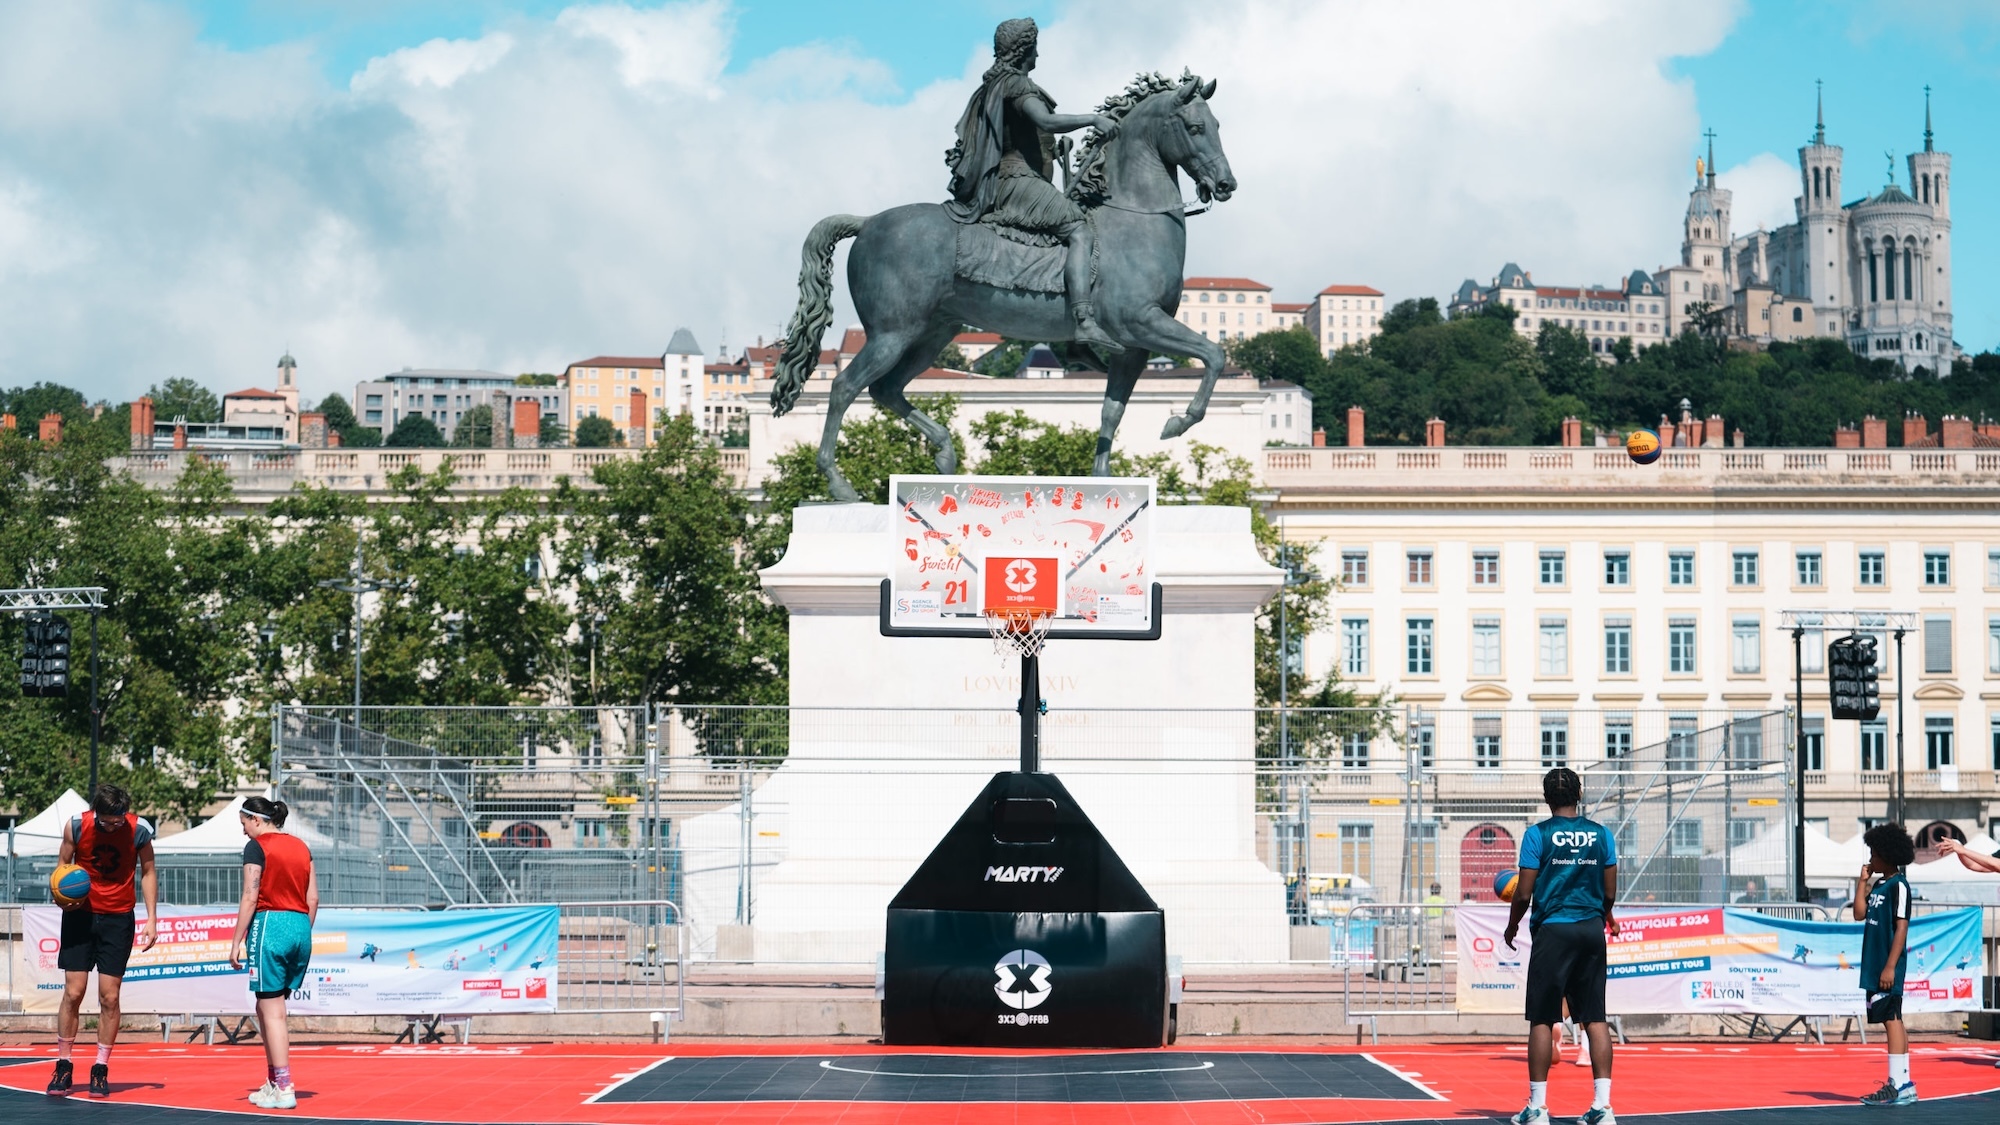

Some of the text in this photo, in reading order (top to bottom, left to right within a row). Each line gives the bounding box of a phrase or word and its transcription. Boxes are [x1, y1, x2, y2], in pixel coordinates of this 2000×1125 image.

[1120, 529, 1134, 543] 23
[920, 556, 964, 575] Swish!
[944, 580, 968, 605] 21
[1047, 676, 1080, 691] XIV
[1552, 831, 1598, 847] GRDF
[1578, 858, 1598, 866] Contest
[984, 866, 1058, 882] MARTY
[1868, 894, 1886, 908] DF
[175, 917, 238, 931] OLYMPIQU
[1620, 914, 1710, 931] LYMPIQUE 2024
[178, 931, 209, 942] LYON
[250, 919, 260, 952] PLAGNE
[249, 955, 256, 966] LA
[1614, 965, 1637, 974] POUR
[1638, 963, 1670, 973] TOUTES
[1671, 962, 1681, 971] ET
[1682, 959, 1705, 969] TOUS
[150, 966, 161, 976] DE
[162, 965, 177, 975] JEU
[178, 962, 202, 973] POUR
[1713, 989, 1744, 999] LYON
[998, 1014, 1050, 1025] 3X3 FFBB
